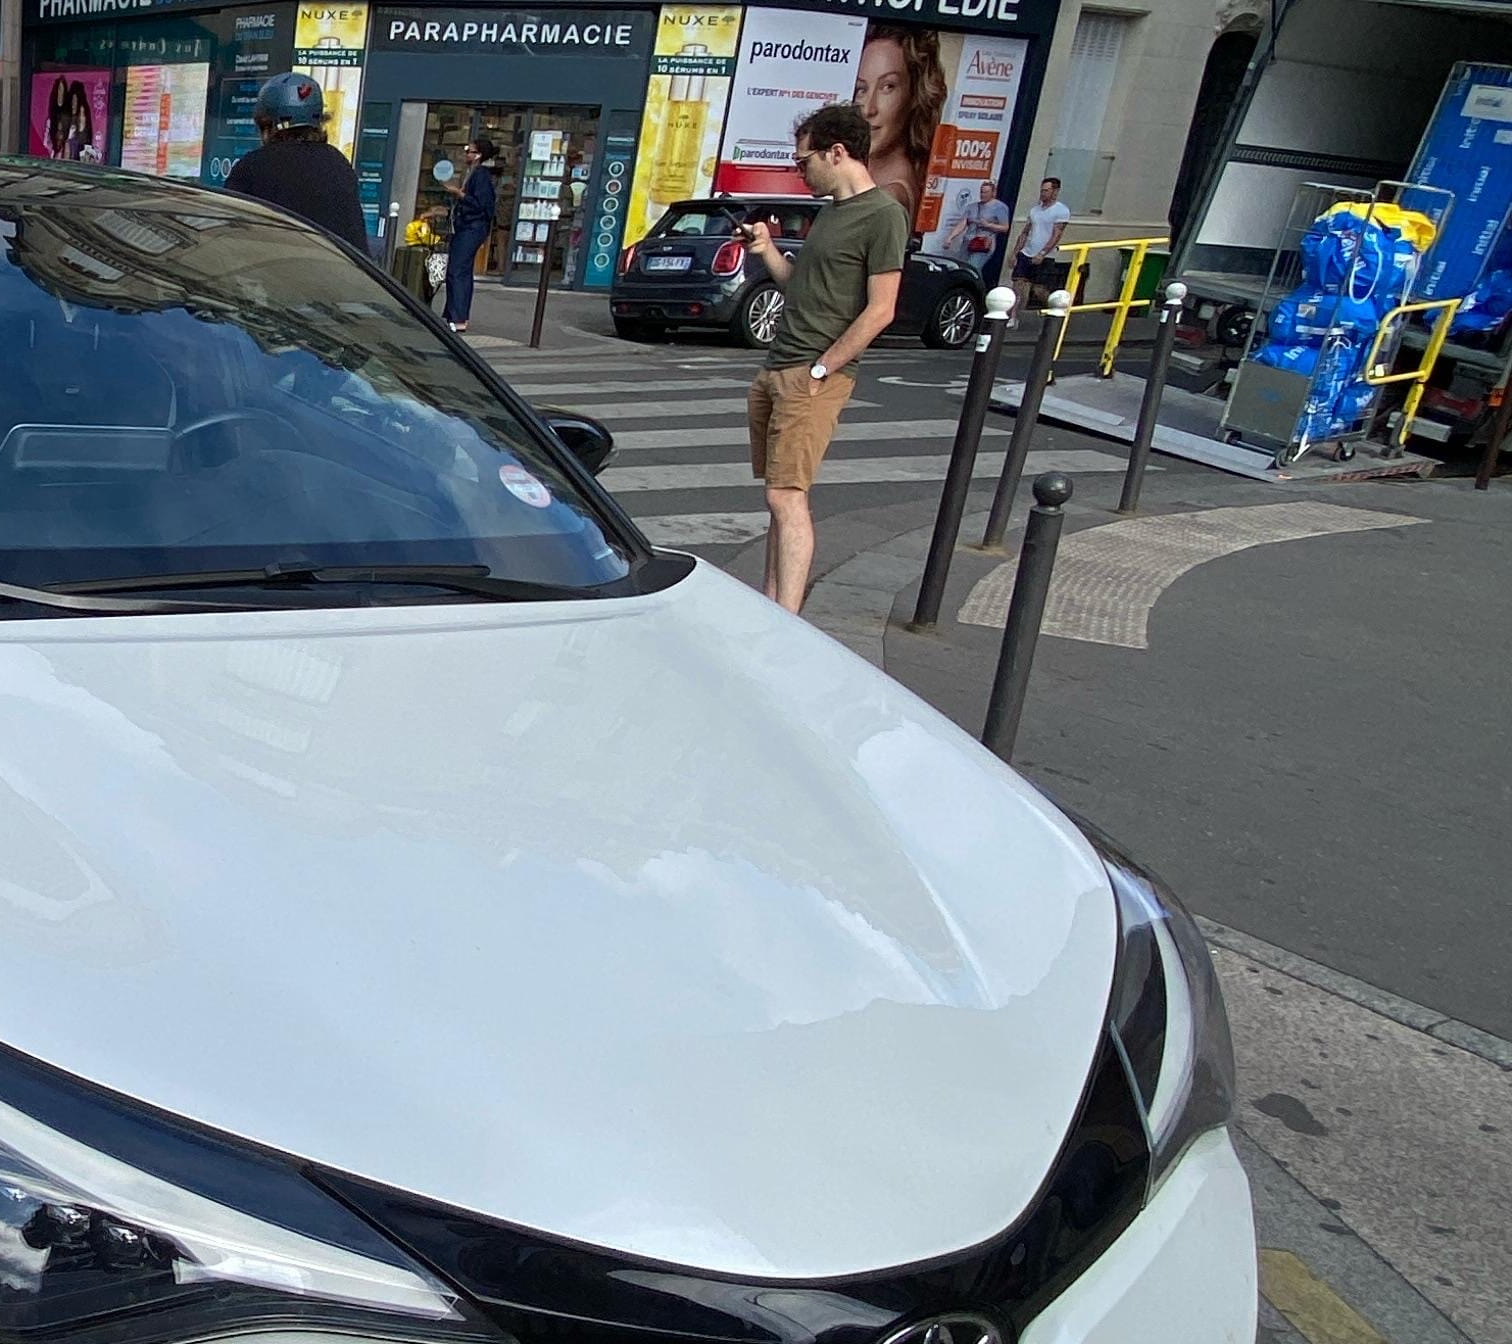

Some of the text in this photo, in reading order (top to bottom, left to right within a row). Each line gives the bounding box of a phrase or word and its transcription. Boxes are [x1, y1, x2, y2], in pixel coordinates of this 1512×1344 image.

[300, 10, 349, 21] NUXE
[663, 15, 719, 27] NUXE
[388, 20, 633, 46] PARAPHARMACIE
[749, 39, 852, 64] parodontax
[670, 57, 714, 65] PUISSANCE
[966, 49, 1014, 77] Avène
[657, 64, 668, 73] 10
[669, 65, 705, 74] SÉRUMS
[746, 87, 779, 97] L'EXPERT
[740, 148, 790, 161] parodontax
[954, 139, 992, 158] 100%
[951, 158, 990, 171] INVISIBLE
